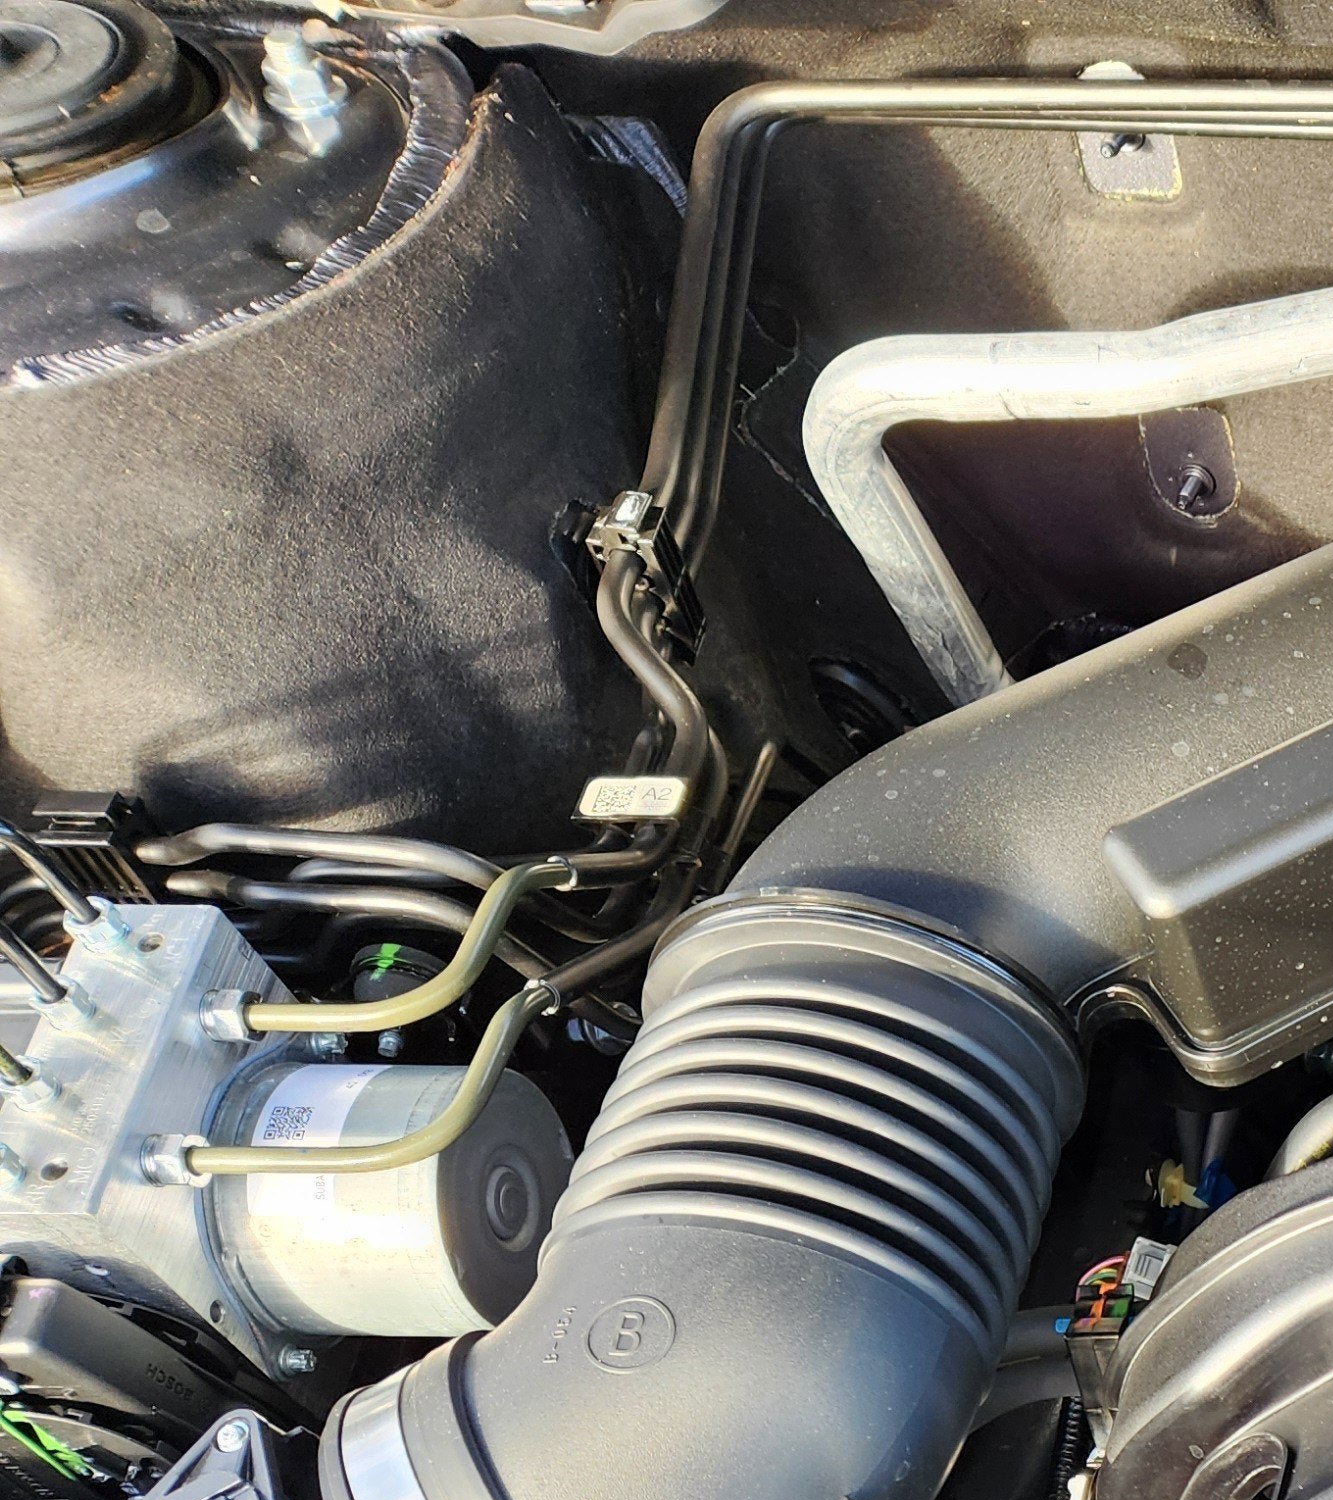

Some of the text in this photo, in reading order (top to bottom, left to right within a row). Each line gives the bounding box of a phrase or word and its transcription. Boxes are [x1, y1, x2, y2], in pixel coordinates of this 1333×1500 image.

[641, 787, 671, 801] A2
[608, 1310, 645, 1357] B
[147, 1363, 195, 1399] BOSCH
